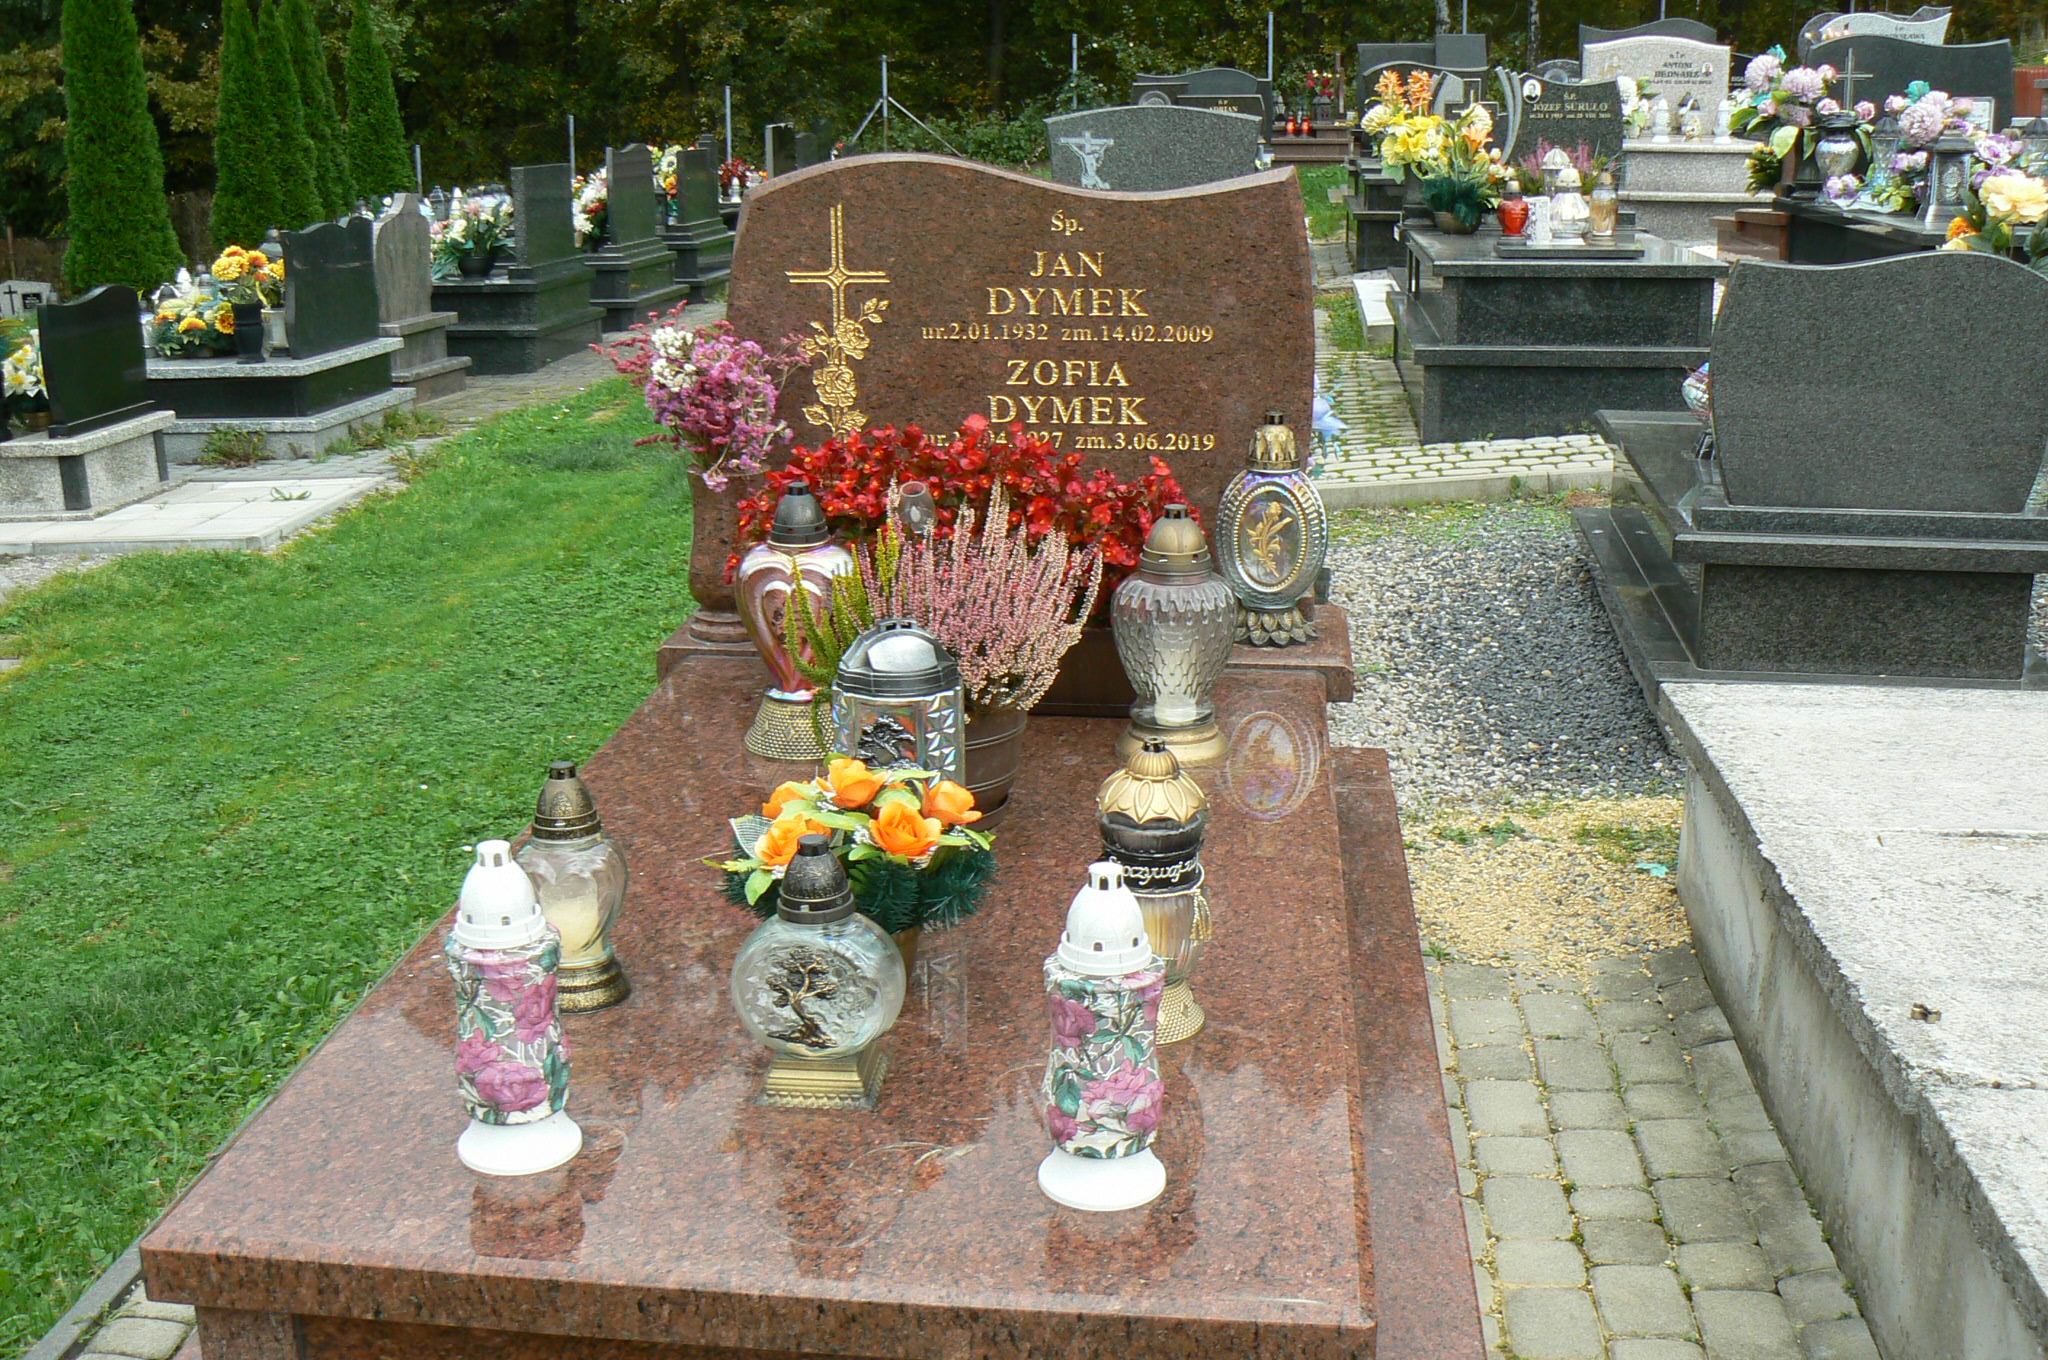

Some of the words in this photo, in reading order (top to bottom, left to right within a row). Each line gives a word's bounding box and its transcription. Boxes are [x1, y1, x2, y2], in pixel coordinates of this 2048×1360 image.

[1050, 209, 1085, 236] Śp.
[1029, 251, 1105, 278] JAN
[986, 287, 1149, 317] DYMEK
[921, 322, 1049, 341] ur.2.01.1932
[1061, 324, 1215, 343] zm.14.02.2009
[1005, 359, 1130, 387] ZOFIA
[987, 395, 1149, 425] DYMEK
[1075, 431, 1216, 451] zm.3.06.2019
